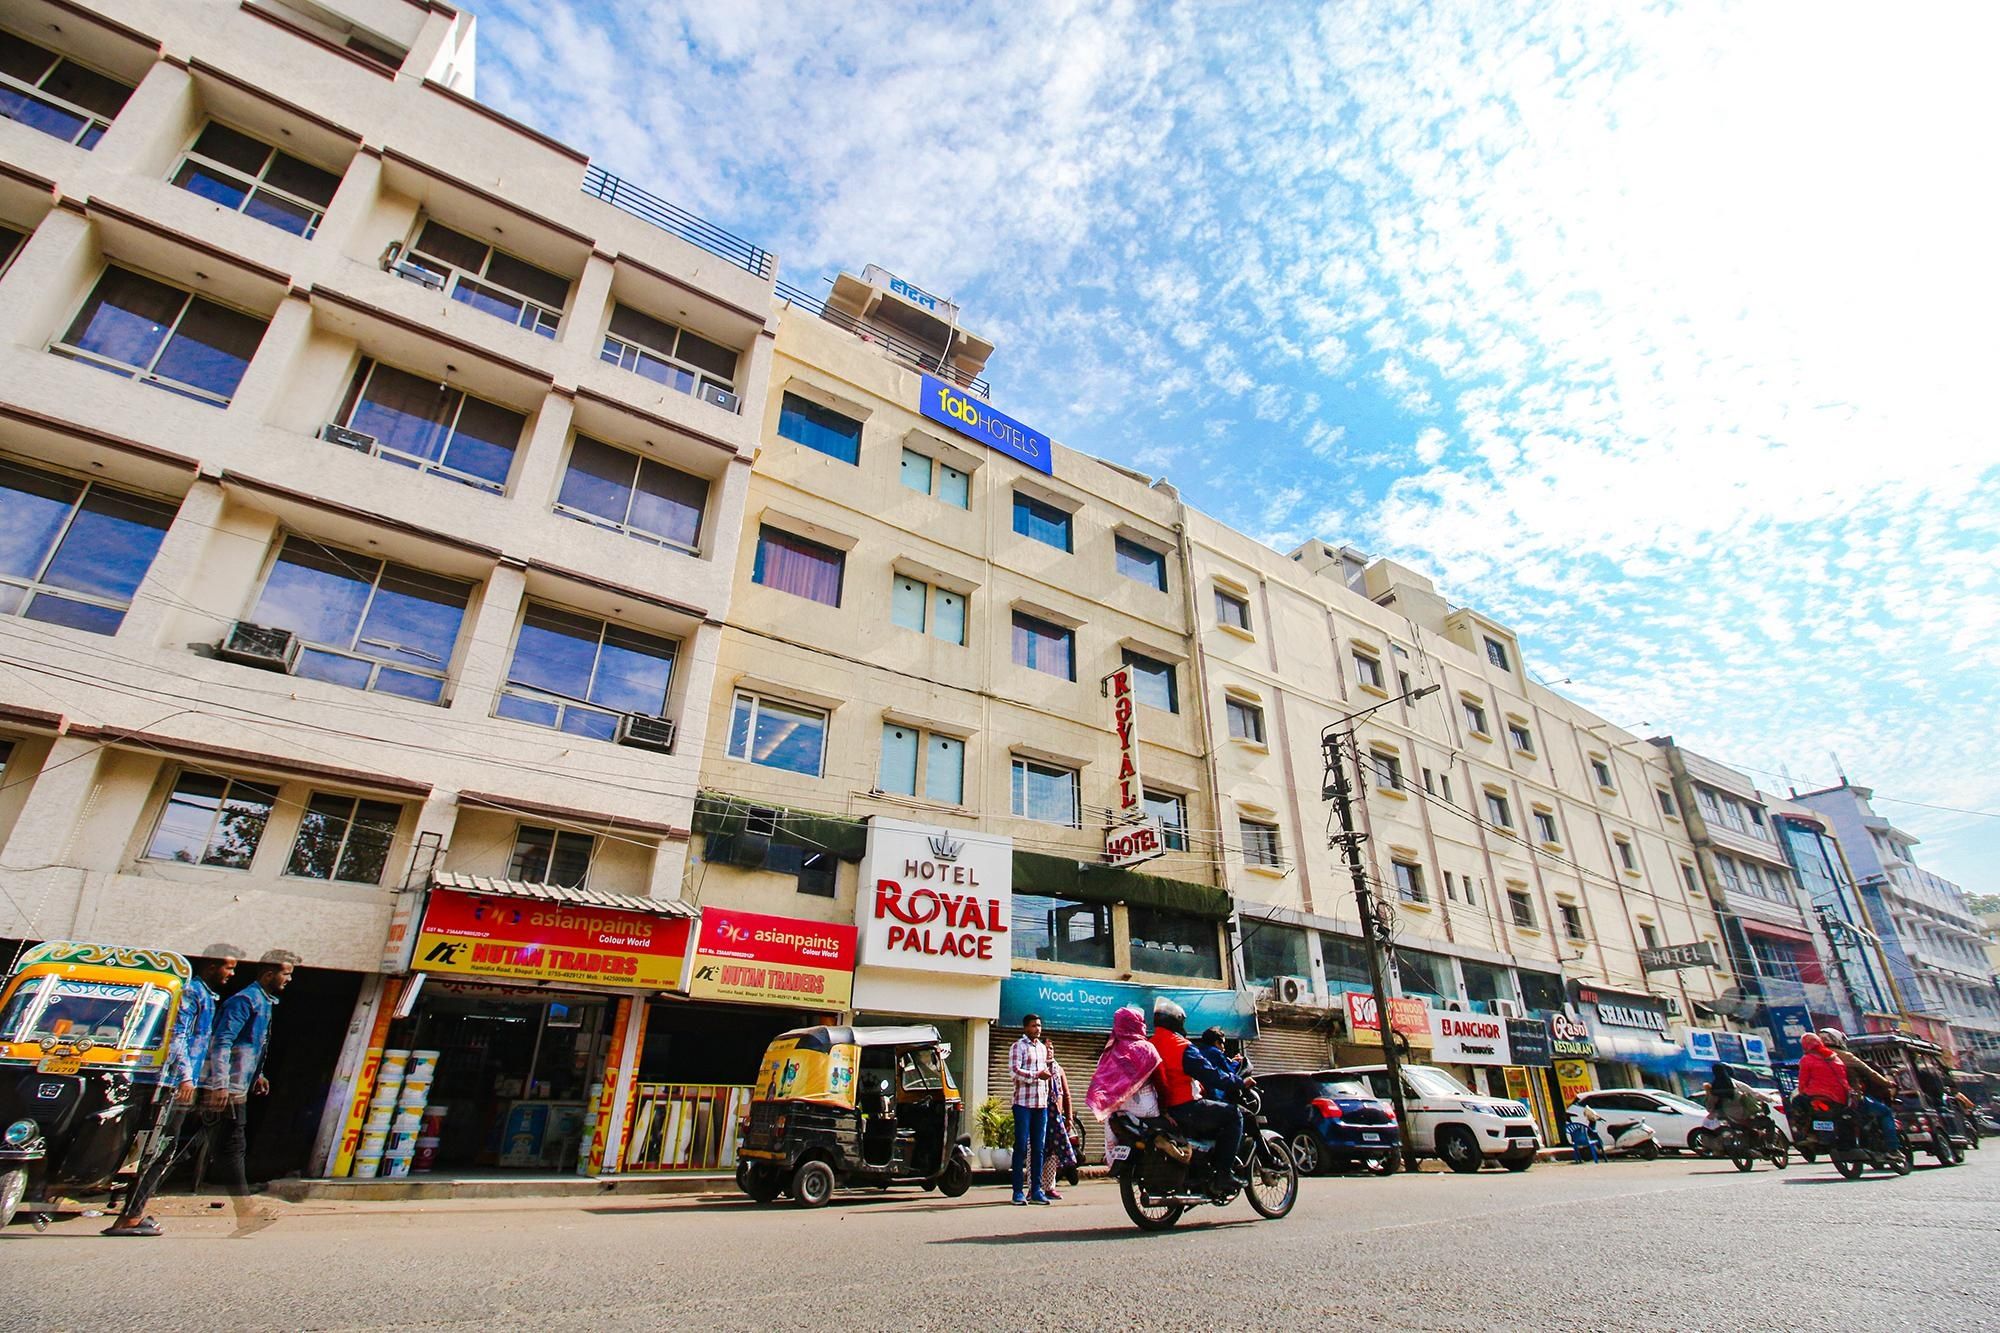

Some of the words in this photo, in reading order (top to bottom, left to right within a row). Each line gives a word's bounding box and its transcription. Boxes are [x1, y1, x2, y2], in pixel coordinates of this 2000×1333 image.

[1112, 671, 1137, 810] ROYAL
[1107, 827, 1159, 863] HOTEL
[904, 859, 980, 886] HOTEL
[875, 879, 1008, 932] ROYAL
[530, 909, 653, 940] asianpaints
[598, 934, 626, 945] Colour
[627, 937, 651, 948] World
[754, 928, 840, 952] asianpaints
[802, 947, 821, 957] Colour
[821, 949, 839, 959] World
[887, 926, 993, 960] PALACE
[471, 942, 545, 968] NUTAN
[549, 949, 639, 976] TRADERS
[1652, 946, 1701, 966] HOTEL
[721, 965, 767, 989] NUTAN
[768, 969, 825, 995] TRADERS
[1038, 986, 1075, 1003] Wood
[1078, 990, 1115, 1006] Decor
[1579, 989, 1599, 1004] HOTEL
[1454, 1020, 1501, 1039] ANCHOR
[1597, 1004, 1665, 1031] SHALIMAR
[588, 1073, 618, 1166] NUTAN
